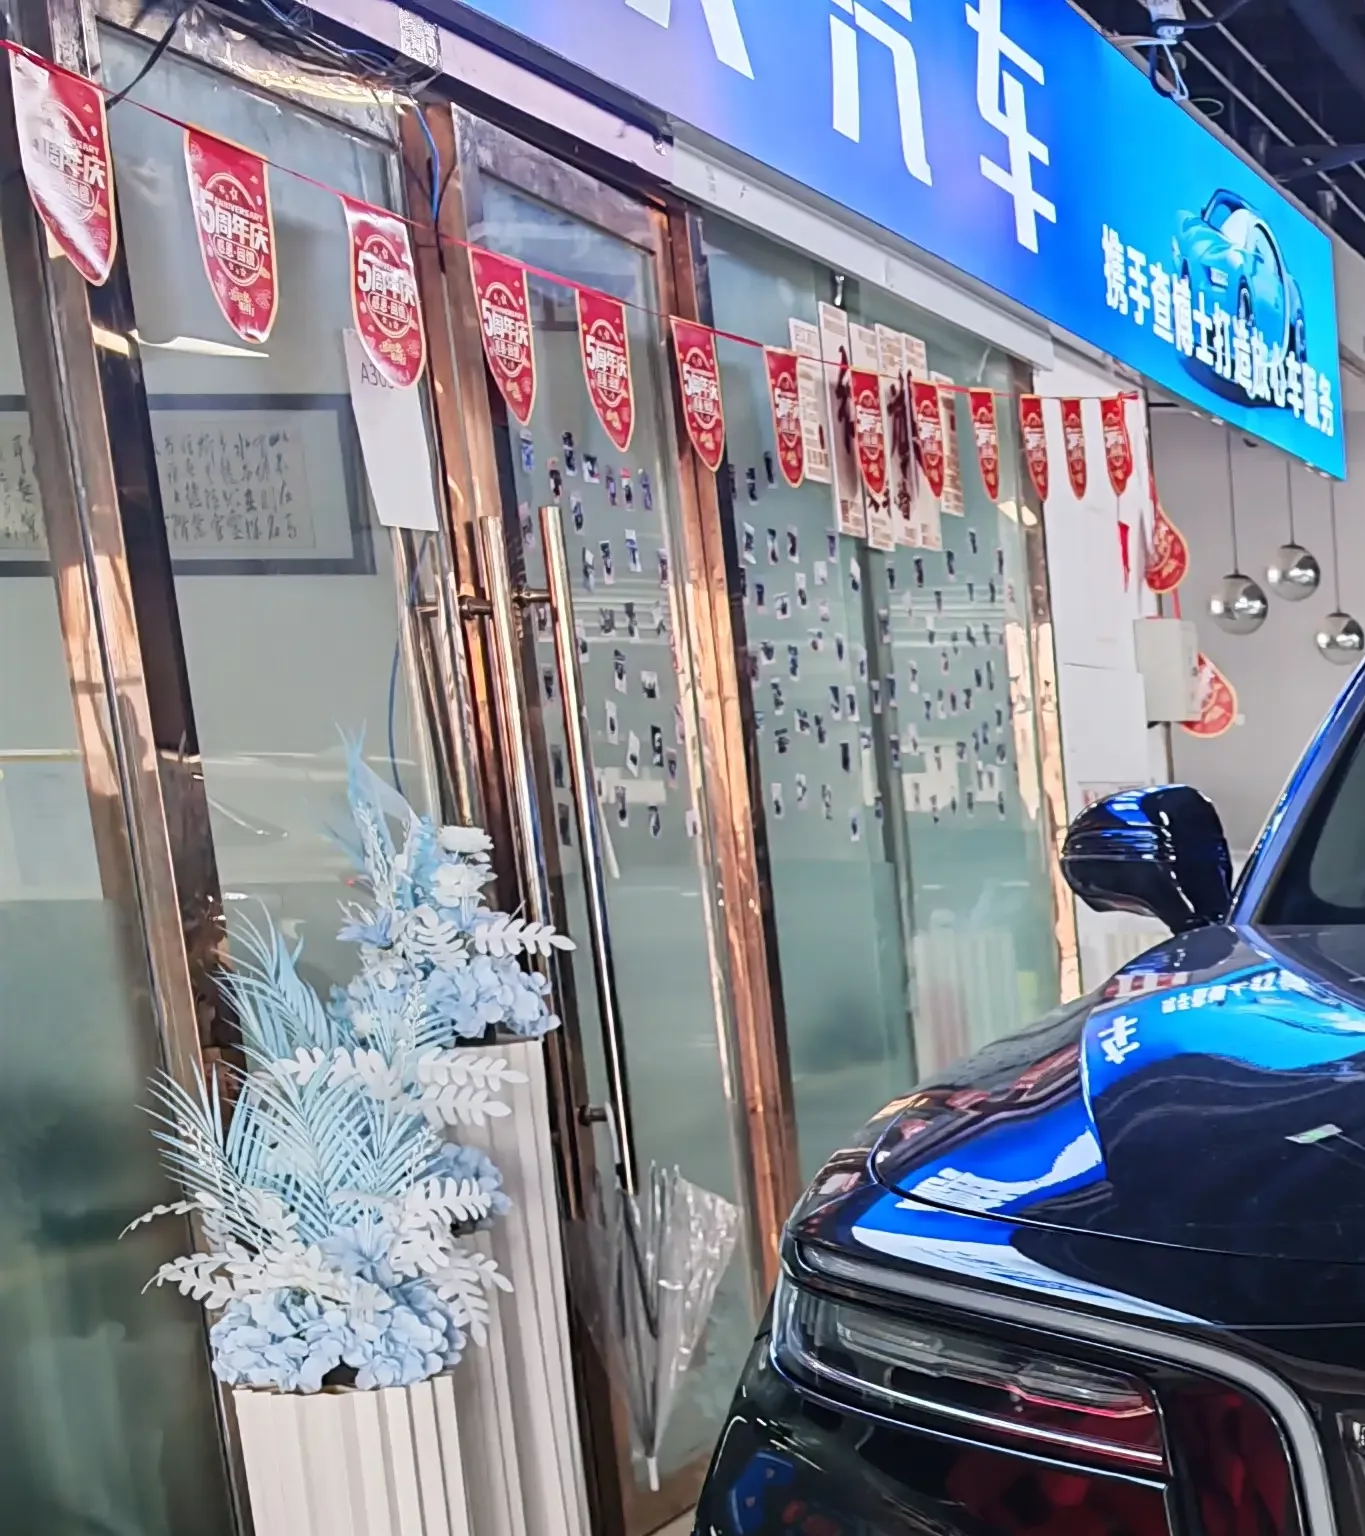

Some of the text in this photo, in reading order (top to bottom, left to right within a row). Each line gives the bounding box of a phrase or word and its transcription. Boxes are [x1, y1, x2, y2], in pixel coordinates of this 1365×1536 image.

[198, 189, 269, 255] 5周年庆
[361, 361, 394, 389] A30
